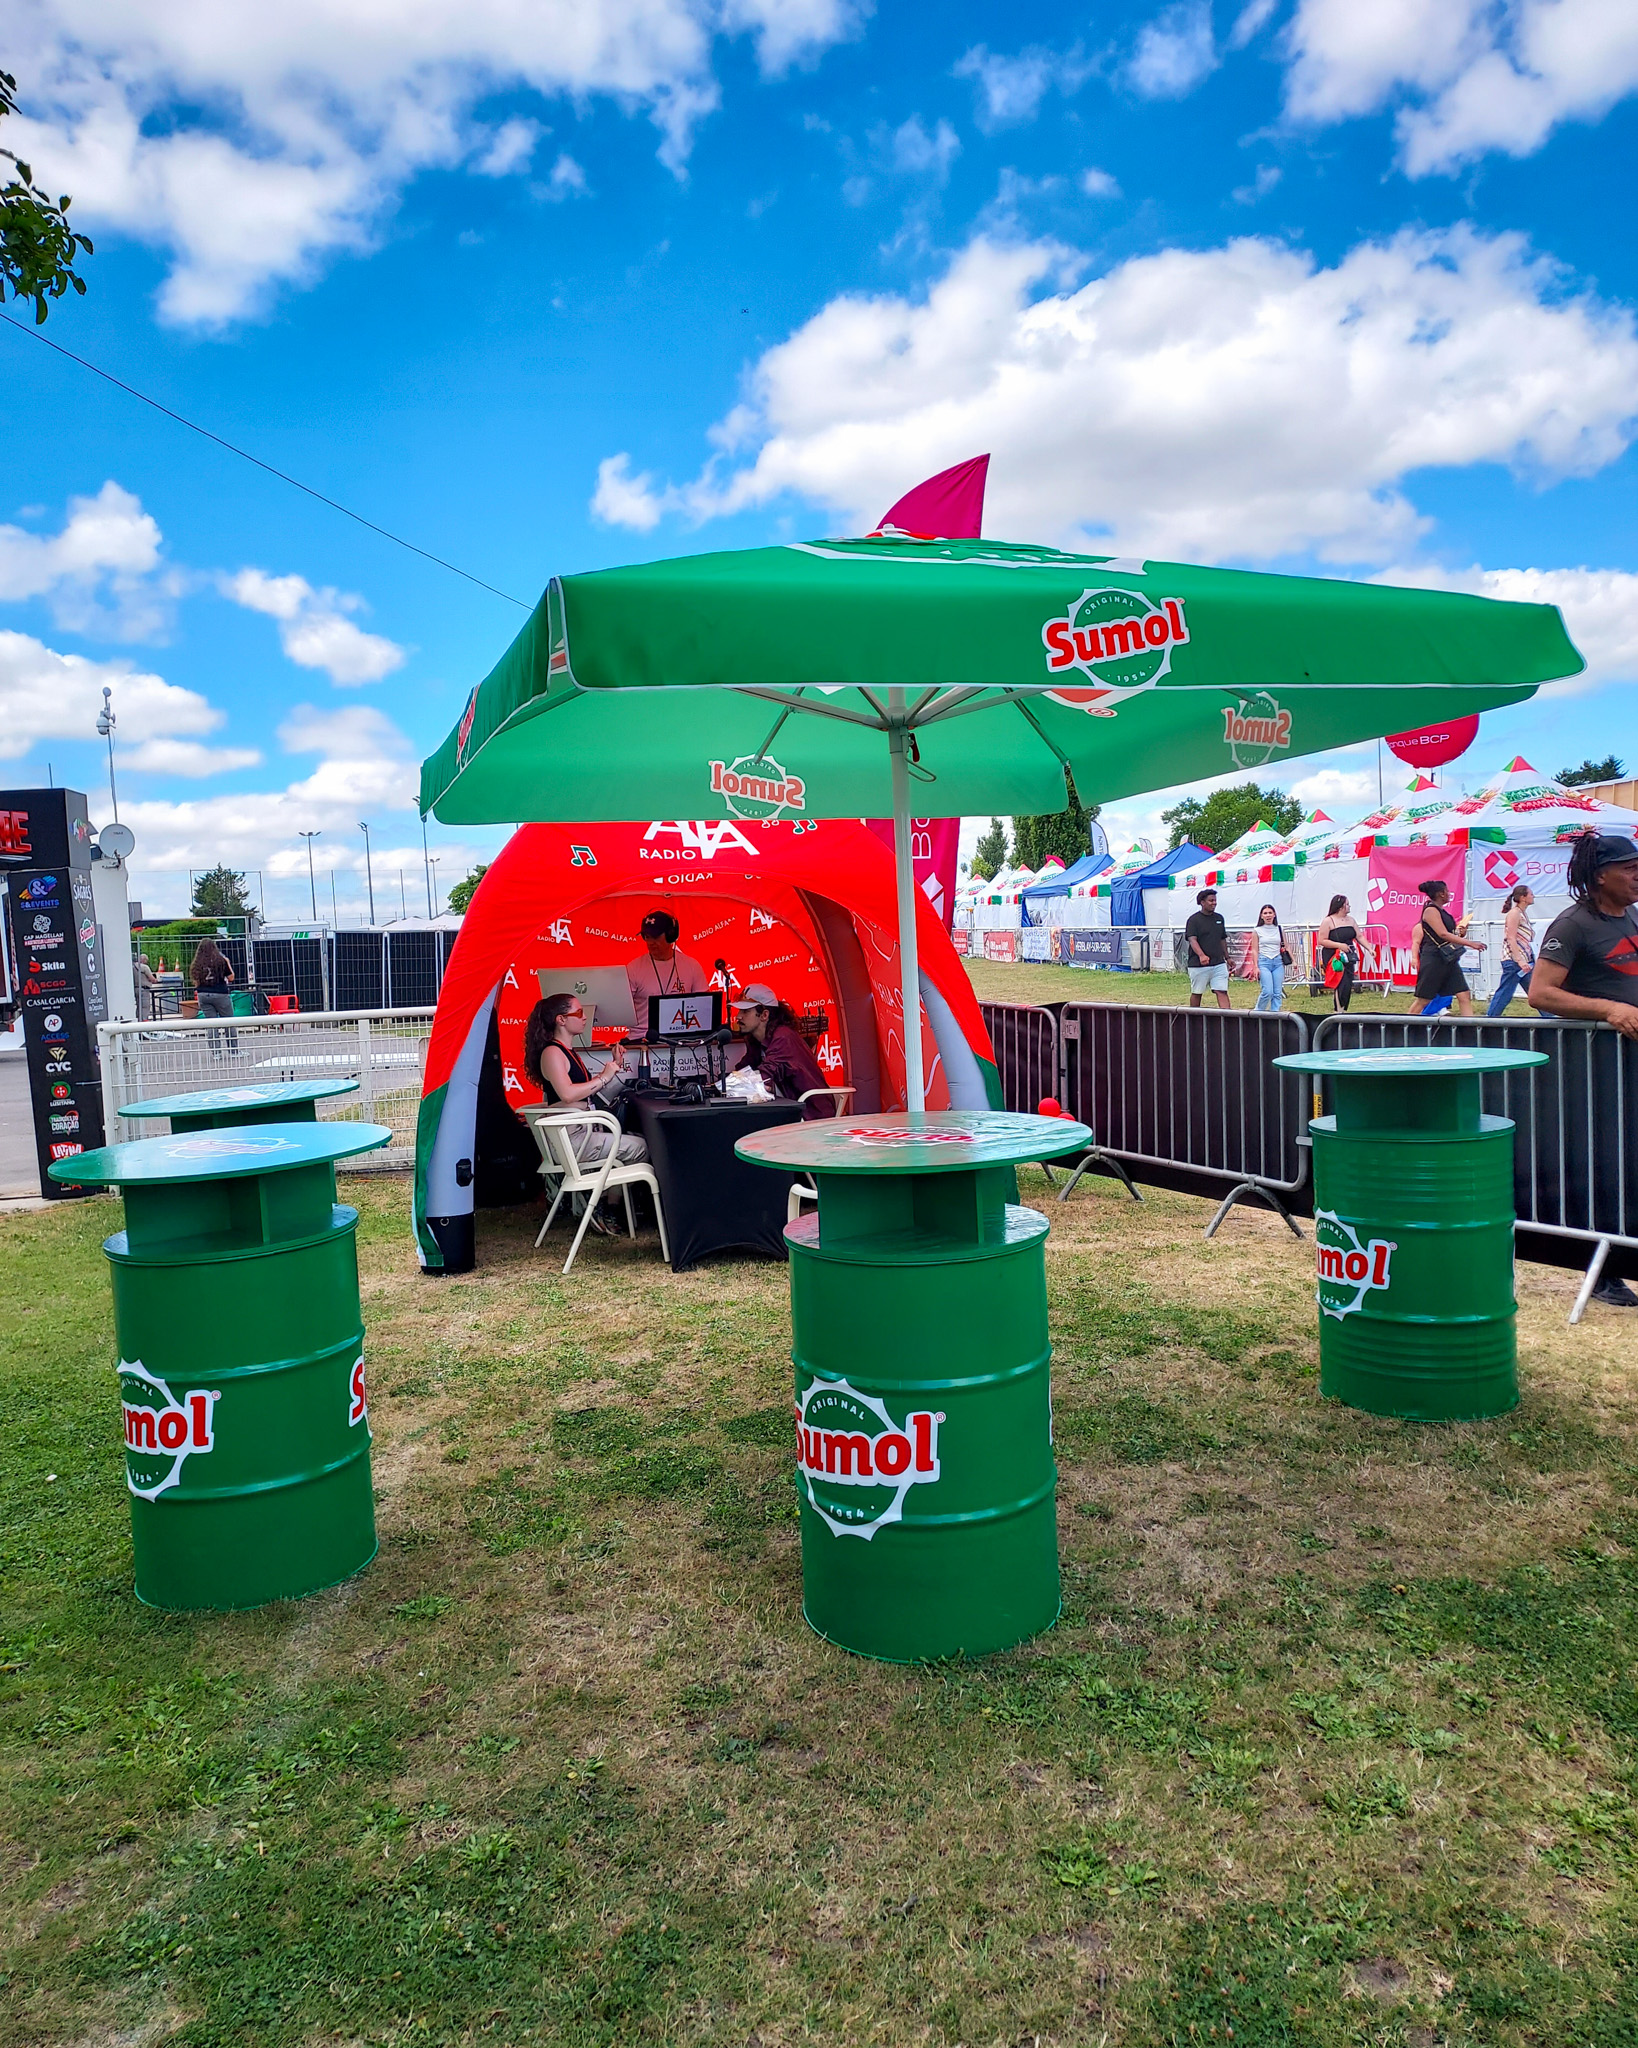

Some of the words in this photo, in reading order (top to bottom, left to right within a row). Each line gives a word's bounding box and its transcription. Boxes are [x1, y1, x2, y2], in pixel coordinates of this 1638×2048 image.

[1084, 596, 1134, 615] ORIGINAL
[1046, 601, 1185, 667] Sumol
[1117, 671, 1146, 682] 1954
[1420, 734, 1450, 745] BCP
[639, 848, 696, 860] RADIO
[1526, 861, 1568, 876] Ban
[73, 884, 92, 900] SAGRES
[21, 899, 59, 909] S&EVENTS
[35, 932, 64, 940] MAGELLAN
[585, 926, 609, 938] RADIO
[611, 933, 628, 943] ALFA
[692, 927, 714, 941] RADIO
[750, 926, 766, 934] RADIO
[537, 935, 555, 943] RADIO
[42, 961, 66, 972] Skita
[749, 959, 772, 971] RADIO
[773, 955, 790, 964] ALFA
[26, 998, 49, 1008] CASAL
[49, 996, 76, 1005] GARCIA
[804, 999, 825, 1008] RADIO
[672, 1000, 701, 1029] ALFA
[817, 1034, 843, 1071] ALFA
[45, 1061, 71, 1072] CYC
[51, 1120, 79, 1131] CORAÇÃO
[811, 1397, 865, 1421] ORIGINAL
[829, 1504, 865, 1520] 1954
